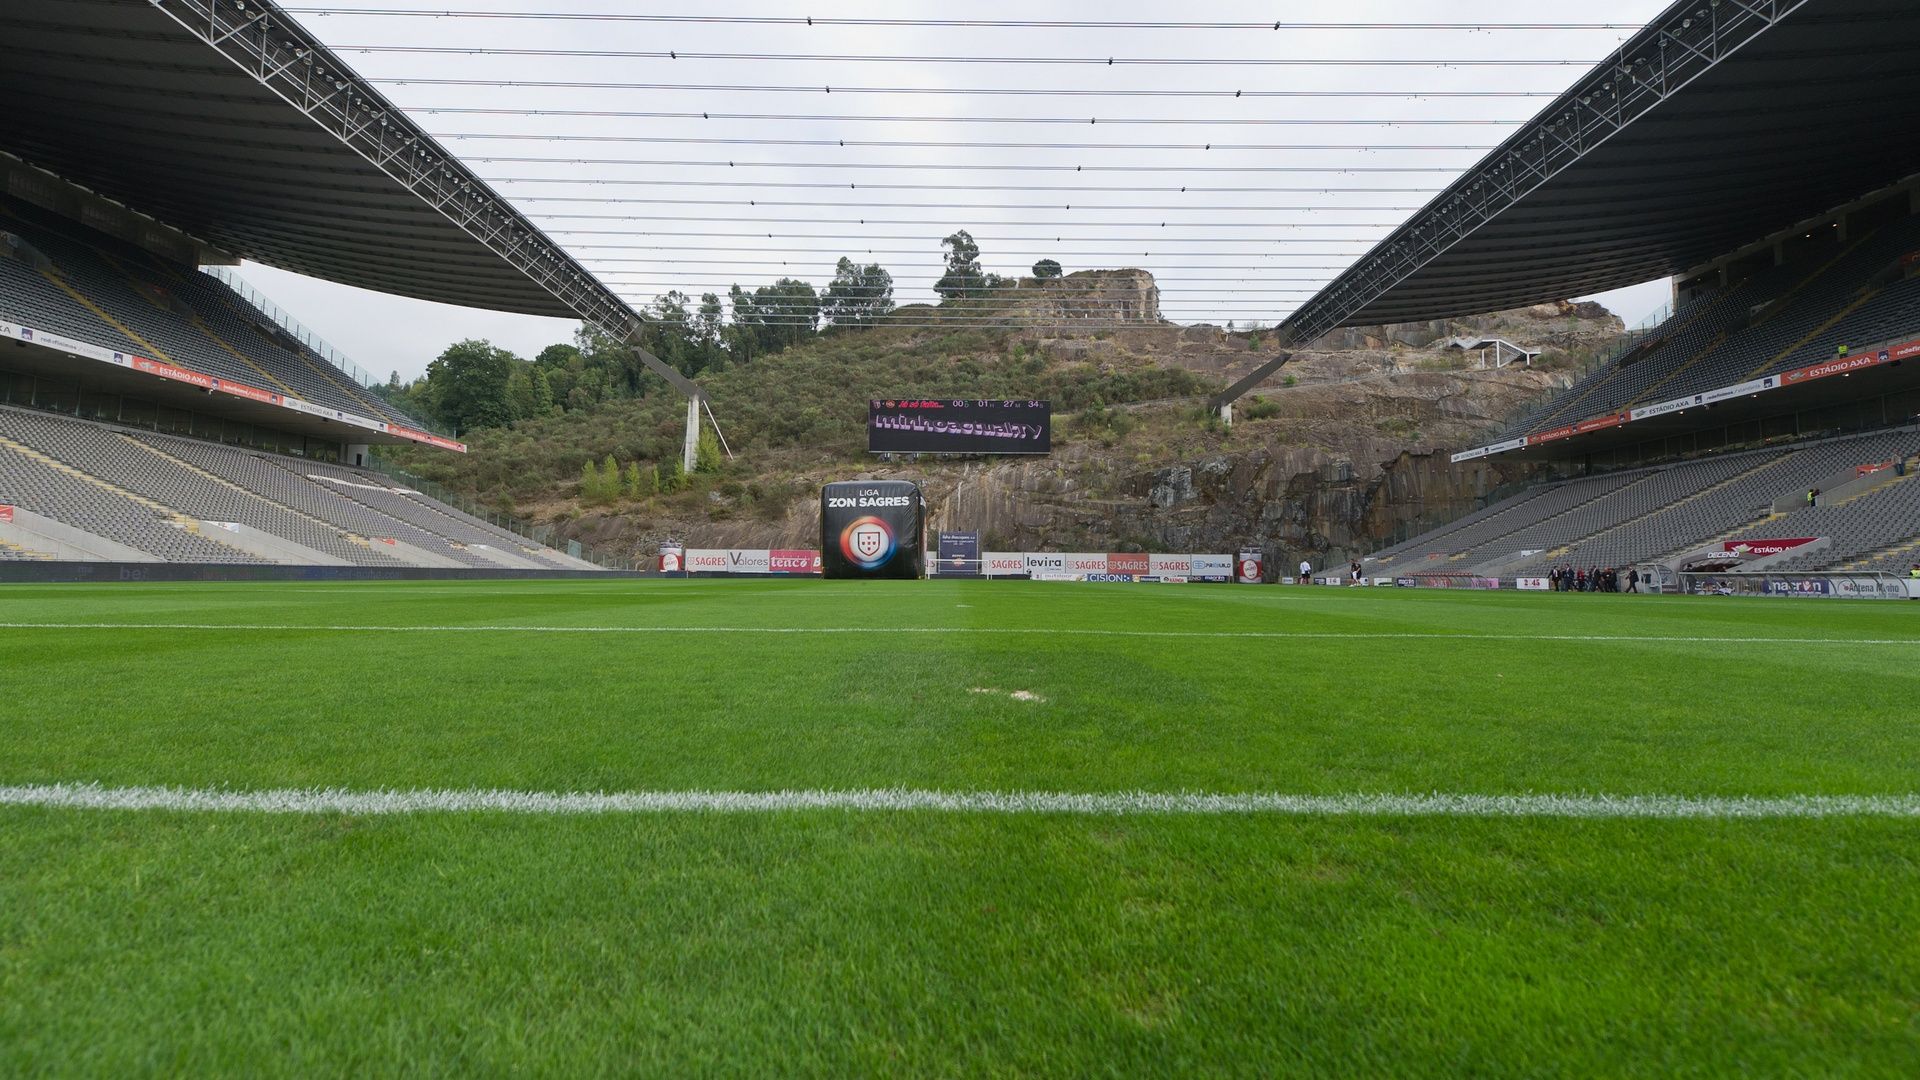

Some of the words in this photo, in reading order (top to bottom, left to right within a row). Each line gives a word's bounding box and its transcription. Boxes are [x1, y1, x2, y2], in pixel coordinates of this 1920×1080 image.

[1809, 362, 1848, 377] ESTÁDIO
[1849, 356, 1871, 368] AXA
[159, 367, 190, 381] ESTÁDIO
[191, 375, 207, 385] AXA
[1649, 404, 1674, 415] ESTÁDIO
[828, 498, 856, 508] ZON
[859, 496, 910, 507] SAGRES
[1754, 546, 1783, 554] ESTÁDIO
[695, 557, 726, 566] SAGRES
[730, 552, 769, 566] Valores
[992, 559, 1022, 569] SAGRES
[1026, 556, 1062, 567] levira
[1076, 560, 1106, 570] SAGRES
[1117, 561, 1148, 570] SAGRES
[1159, 561, 1190, 571] SAGRES
[1089, 574, 1124, 582] CISION
[1849, 583, 1874, 592] Antena
